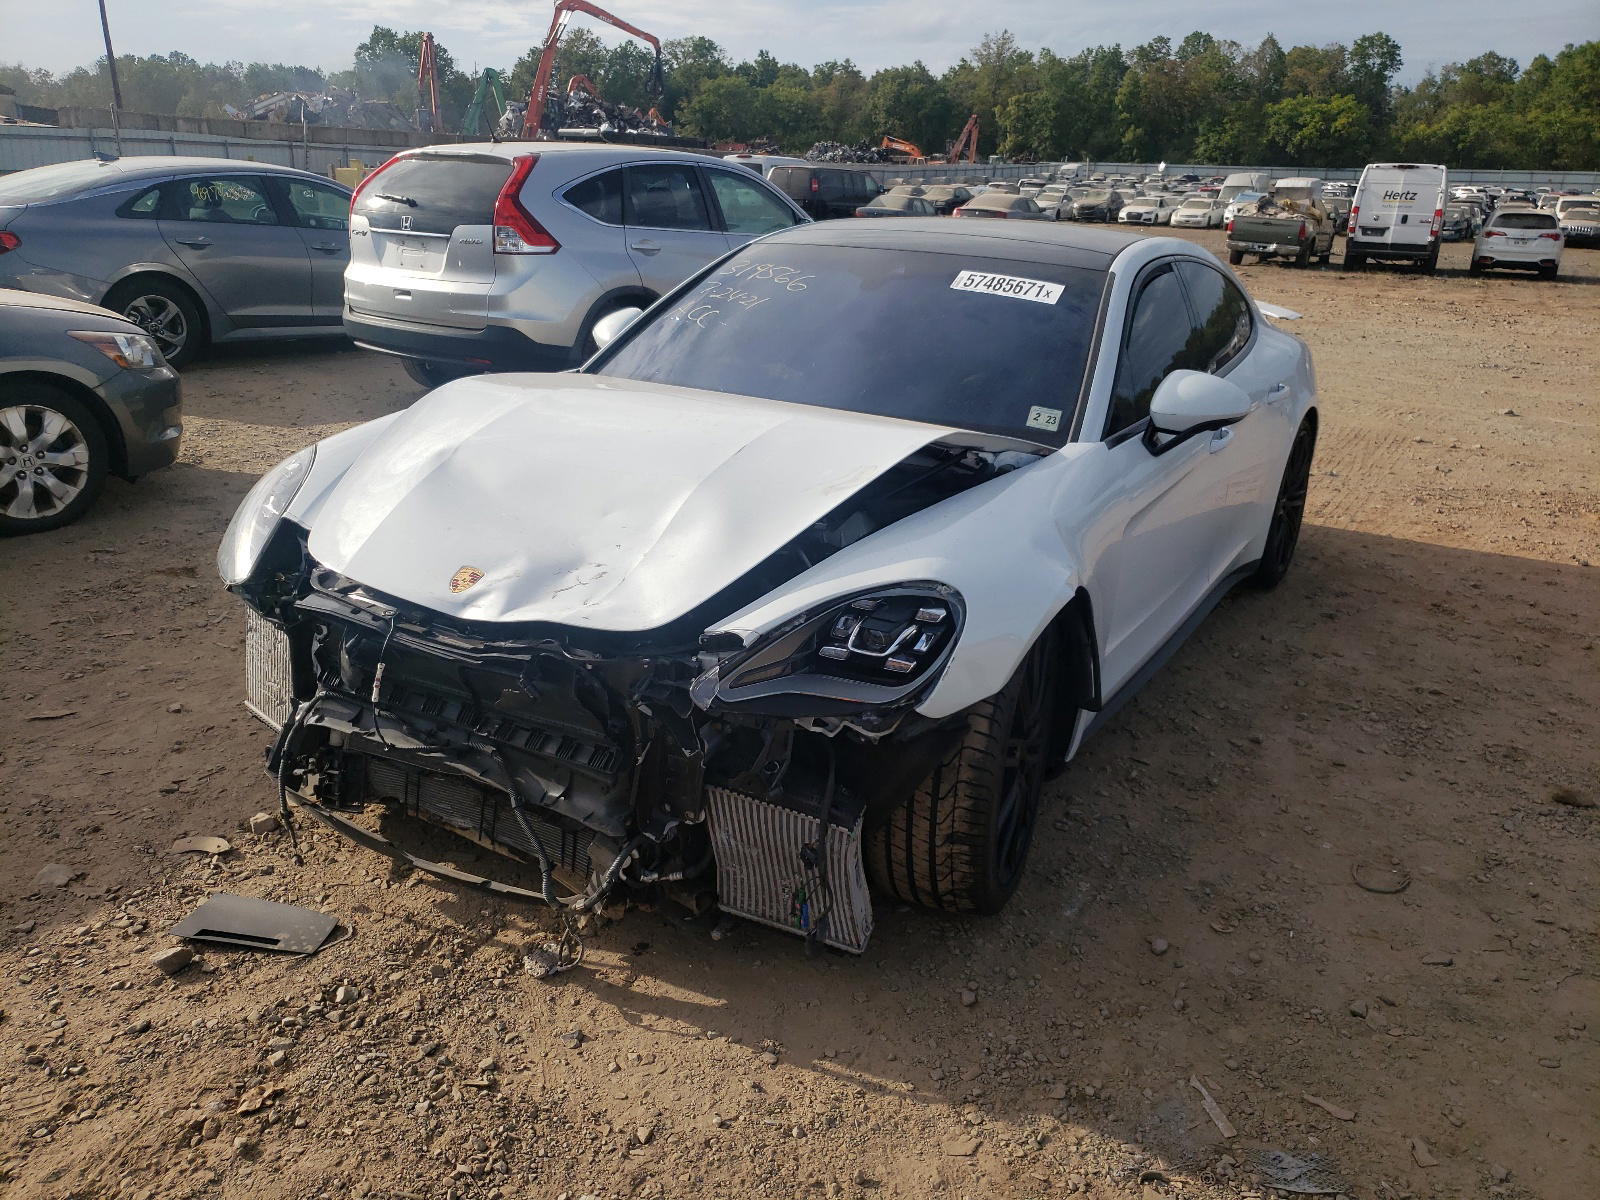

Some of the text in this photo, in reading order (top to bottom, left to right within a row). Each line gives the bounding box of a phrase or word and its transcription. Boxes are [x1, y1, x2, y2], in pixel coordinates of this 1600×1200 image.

[1383, 190, 1418, 201] Hertz
[1033, 412, 1057, 425] 2 23
